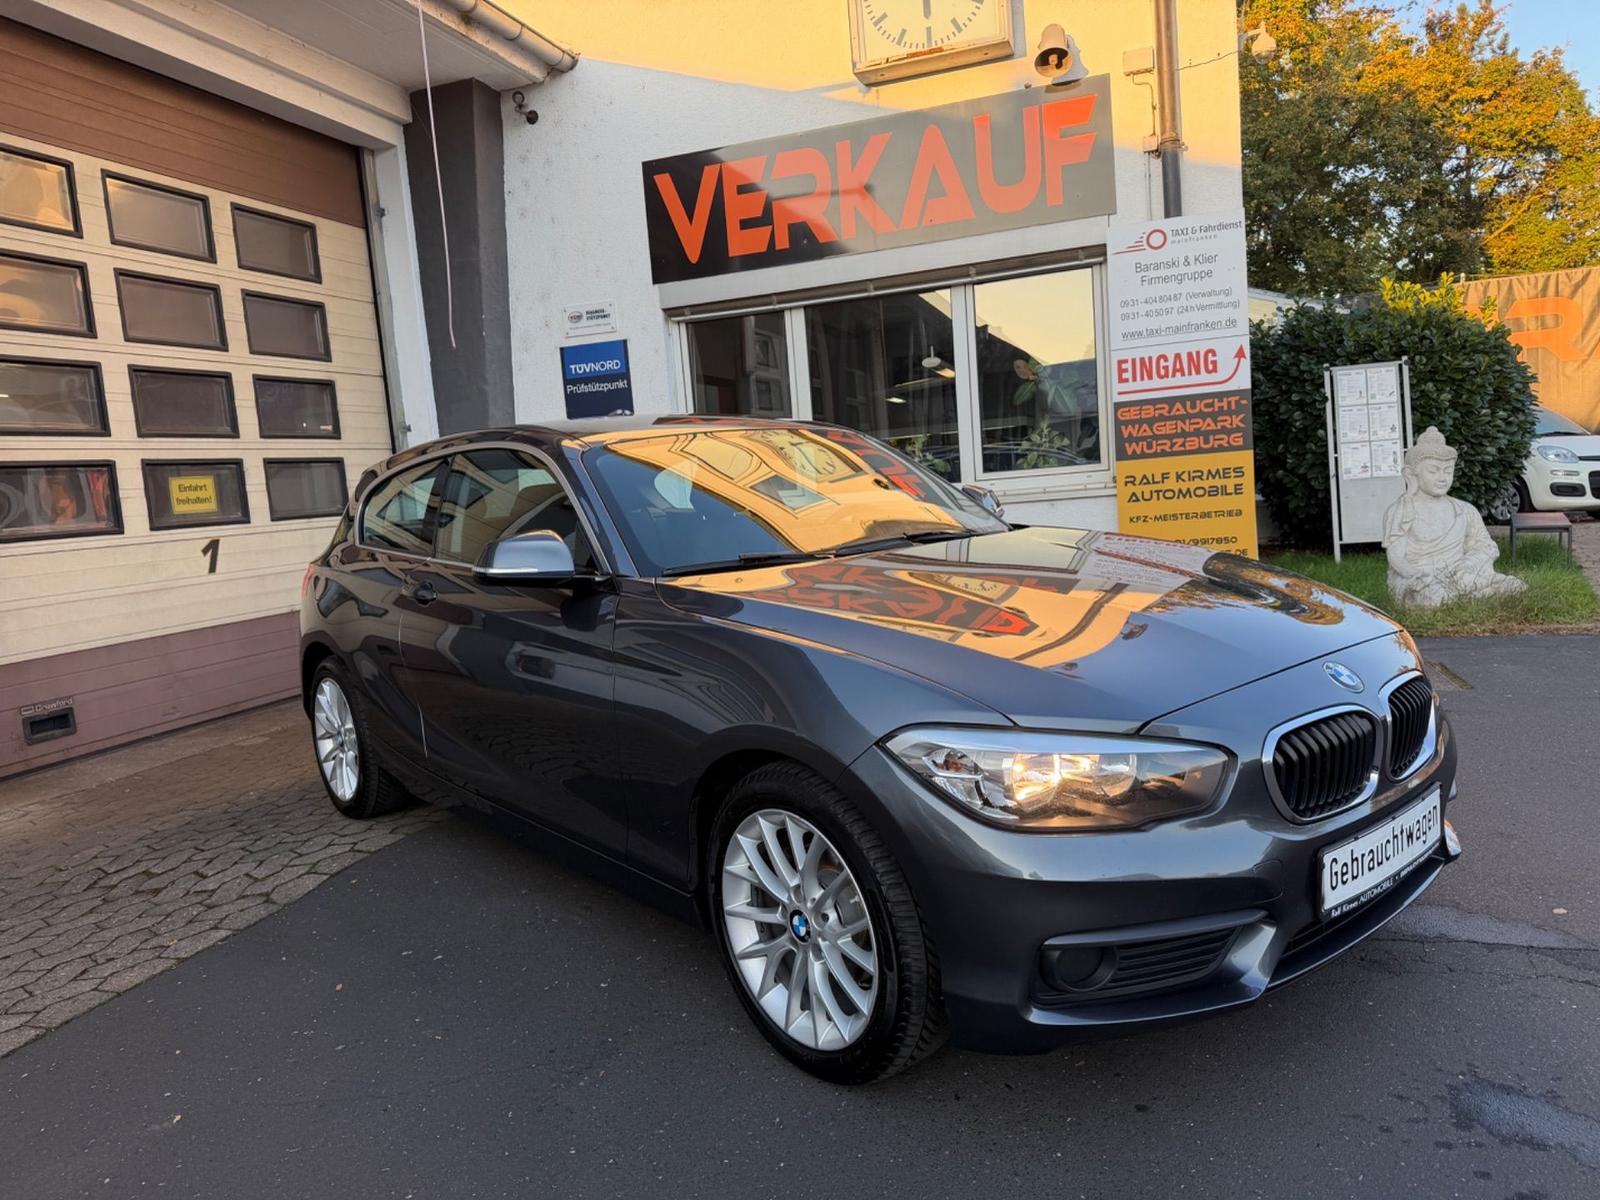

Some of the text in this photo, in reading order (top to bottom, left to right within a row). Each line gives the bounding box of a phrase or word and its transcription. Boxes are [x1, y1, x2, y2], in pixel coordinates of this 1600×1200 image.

[653, 94, 1097, 264] VERKAUF
[1171, 221, 1242, 237] TAXI & Fahrdienst
[1135, 253, 1218, 273] Baranski & Klier
[1140, 268, 1213, 287] Firmengruppe
[1185, 287, 1232, 301] (Verwaltung)
[1117, 348, 1218, 384] EINGANG
[566, 379, 628, 395] Prüfstützpunkt
[1117, 396, 1248, 421] GEBRAUCHT-
[1120, 414, 1246, 439] WAGENPARK
[1124, 466, 1245, 487] RALF KIRMES
[178, 483, 207, 492] Einfahrt
[1127, 483, 1244, 504] AUTOMOBILE
[1129, 509, 1243, 524] KFZ-MEISTERBETRIEB
[201, 538, 220, 574] 1
[1329, 805, 1437, 891] Gebrauchtwagen
[1358, 878, 1393, 905] AUTOMOBILE
